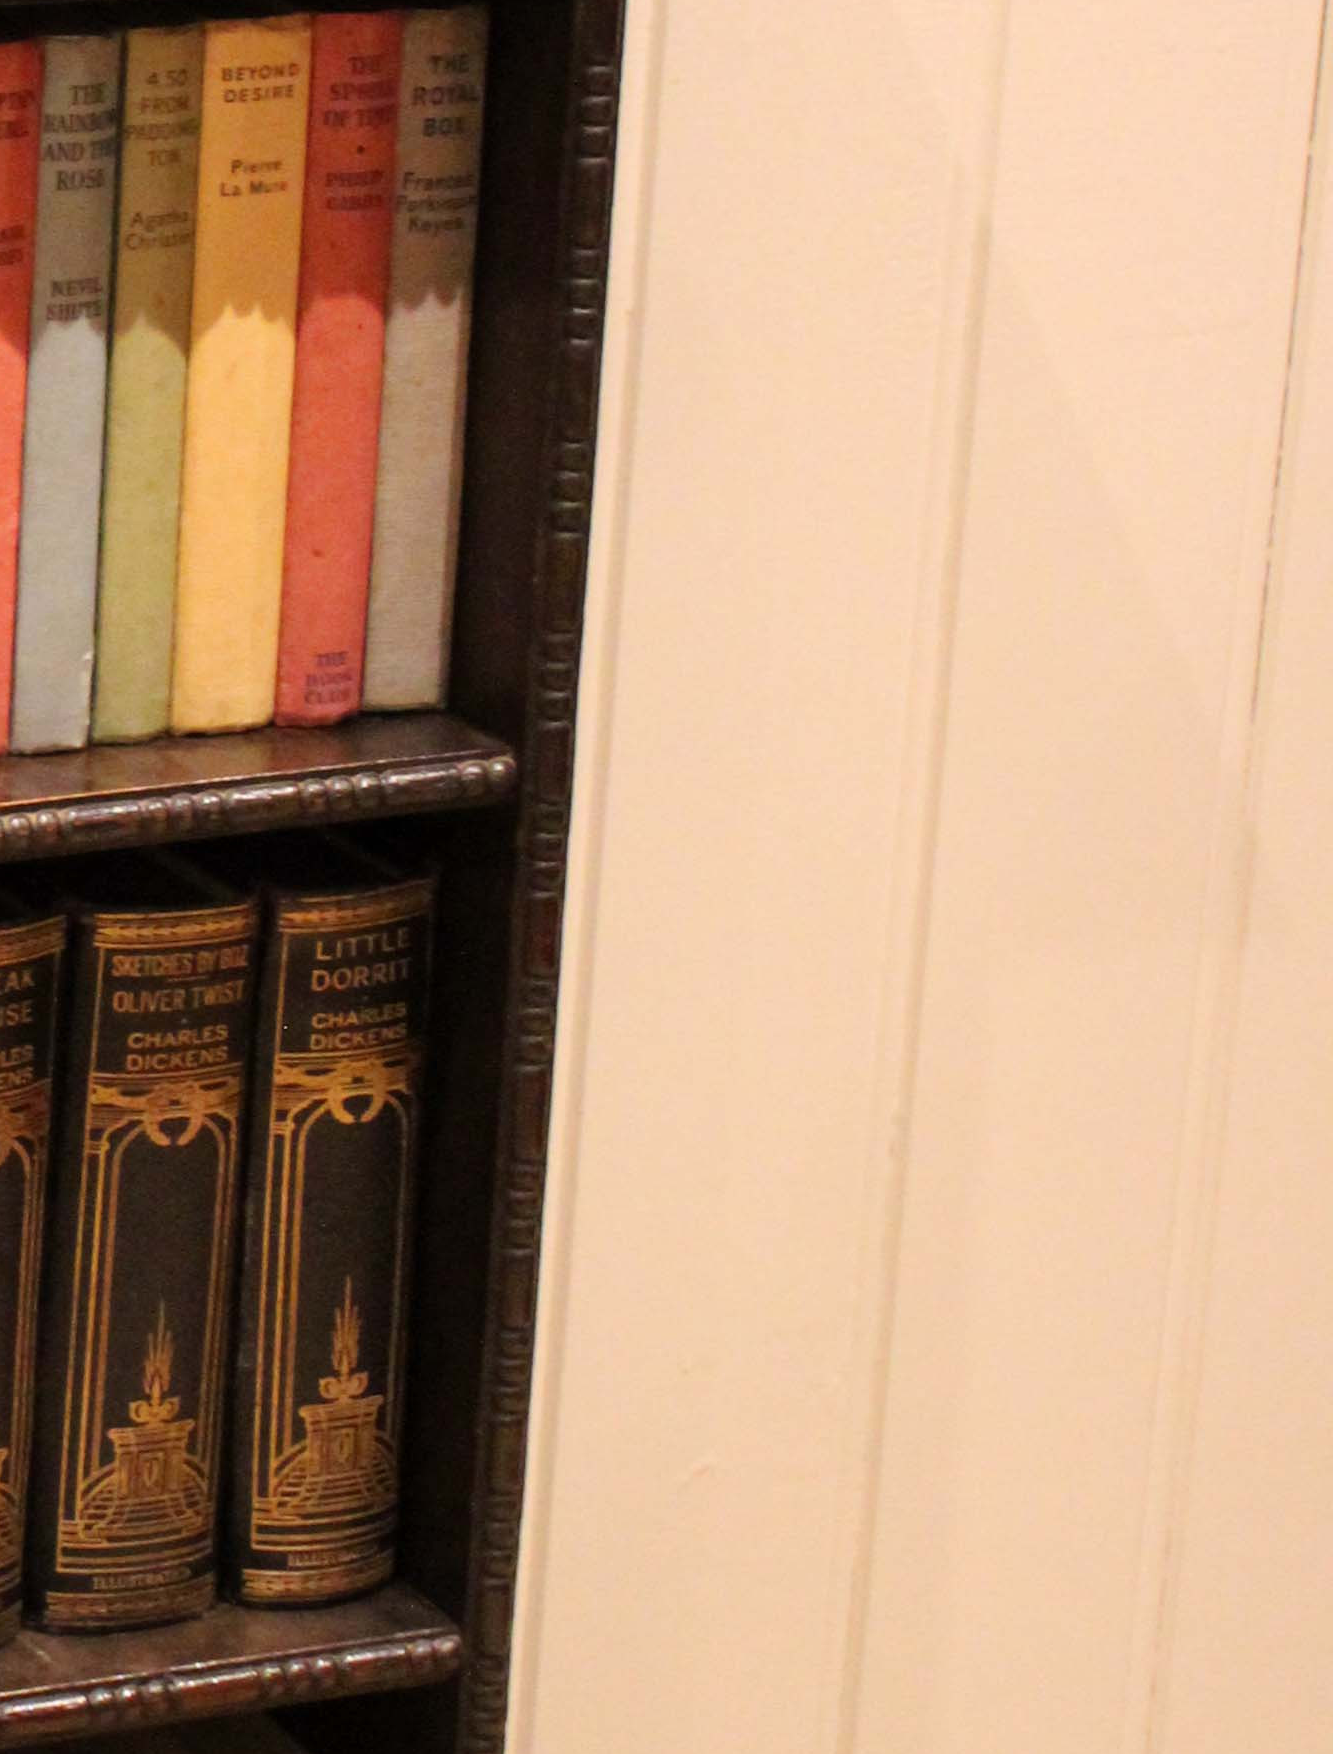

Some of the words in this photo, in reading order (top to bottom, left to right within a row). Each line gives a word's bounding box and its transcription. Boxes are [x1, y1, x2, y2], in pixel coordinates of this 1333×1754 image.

[221, 63, 301, 83] BEYOND
[223, 84, 294, 104] DESIRE
[315, 926, 410, 961] LITTLE
[312, 957, 412, 992] DORRIT
[113, 988, 185, 1013] OLIVER
[312, 1002, 407, 1029] CHARLES
[128, 1024, 229, 1049] CHARLES
[310, 1023, 407, 1050] DICKENS
[126, 1047, 228, 1072] DICKENS
